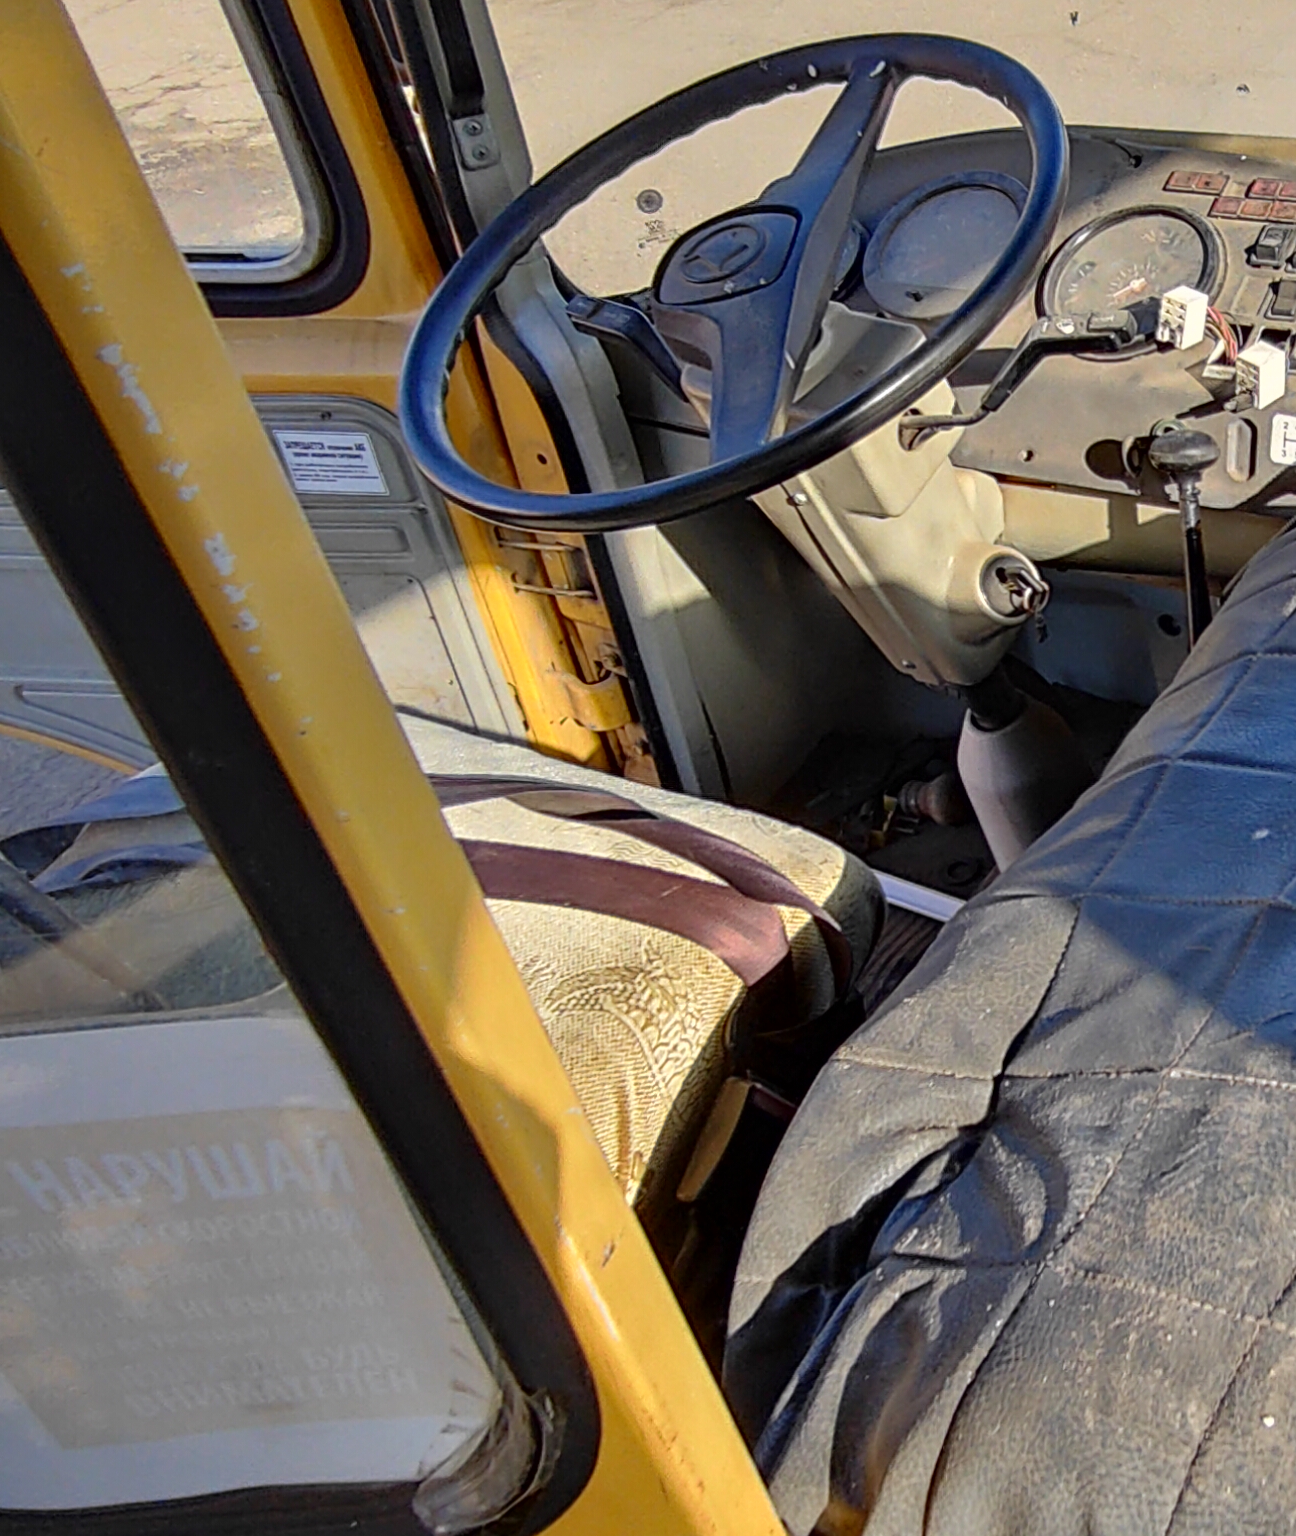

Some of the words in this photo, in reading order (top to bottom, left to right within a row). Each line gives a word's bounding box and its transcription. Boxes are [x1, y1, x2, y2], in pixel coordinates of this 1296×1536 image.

[1283, 422, 1289, 430] 2
[1281, 450, 1287, 458] 3
[5, 1128, 355, 1212] НАРУШАЙ
